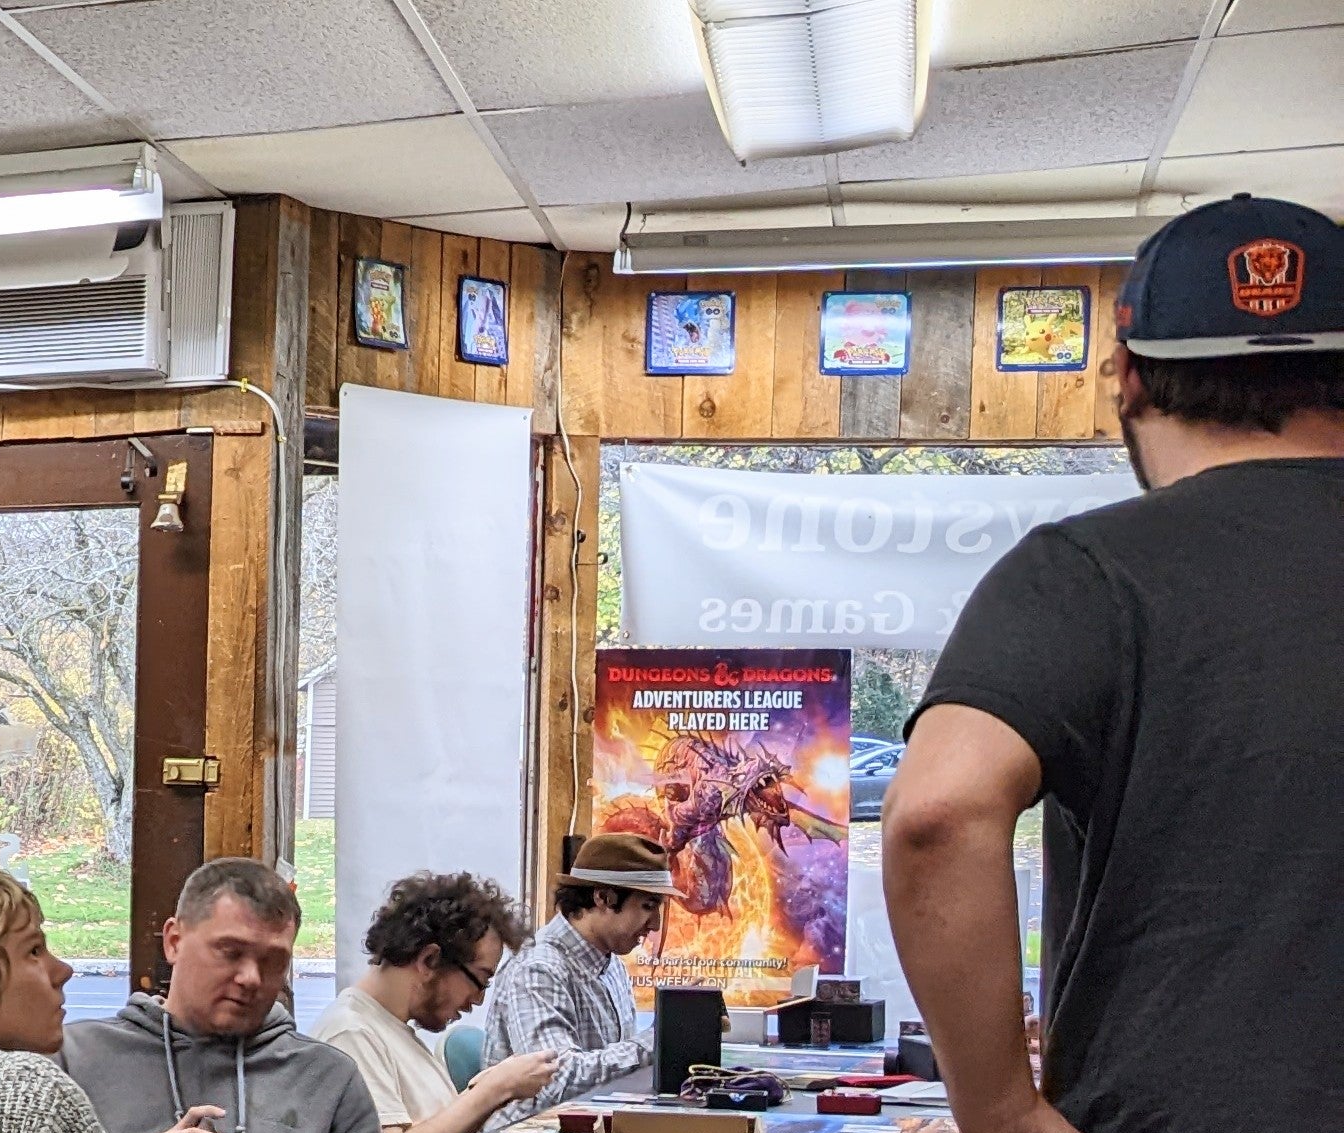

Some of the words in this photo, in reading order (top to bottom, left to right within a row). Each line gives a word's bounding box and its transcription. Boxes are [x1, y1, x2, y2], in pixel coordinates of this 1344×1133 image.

[608, 667, 710, 684] DUNGEONS
[713, 662, 740, 687] &
[742, 667, 833, 683] DRAGONS
[632, 690, 741, 710] ADVENTURERS
[744, 690, 803, 710] LEAGUE
[668, 712, 726, 731] PLAYED
[728, 712, 770, 732] HERE
[636, 955, 651, 966] Be
[720, 956, 788, 969] community!
[637, 976, 653, 987] US
